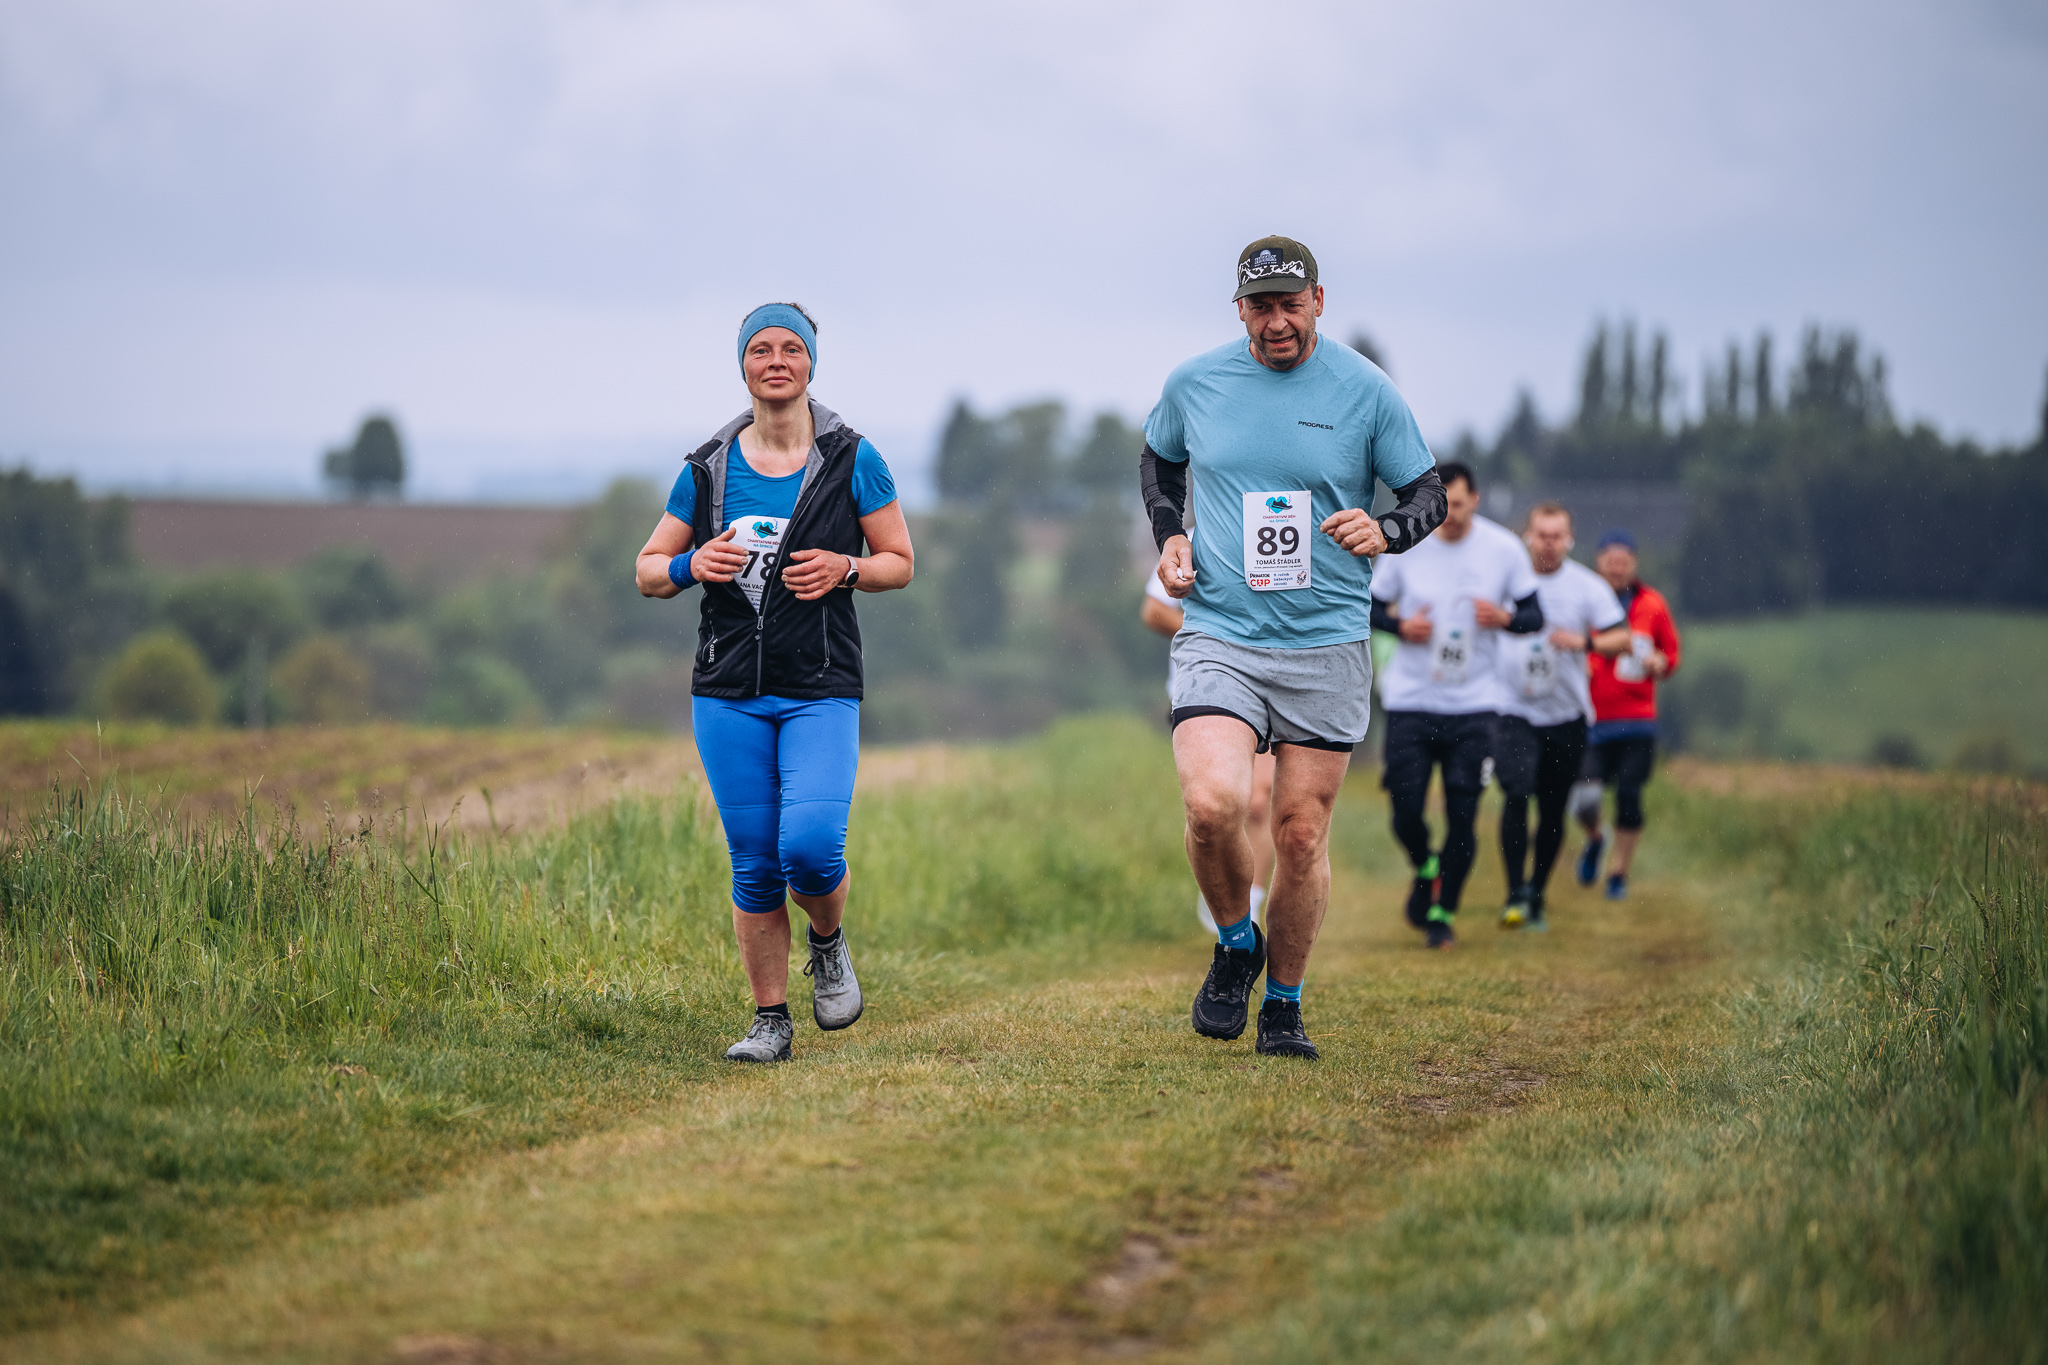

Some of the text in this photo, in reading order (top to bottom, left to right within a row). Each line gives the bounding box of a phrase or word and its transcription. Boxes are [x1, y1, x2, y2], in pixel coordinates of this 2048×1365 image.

[1298, 420, 1334, 430] PROGRESS
[1257, 526, 1299, 556] 89
[741, 550, 777, 580] 78
[1250, 579, 1270, 587] CUP
